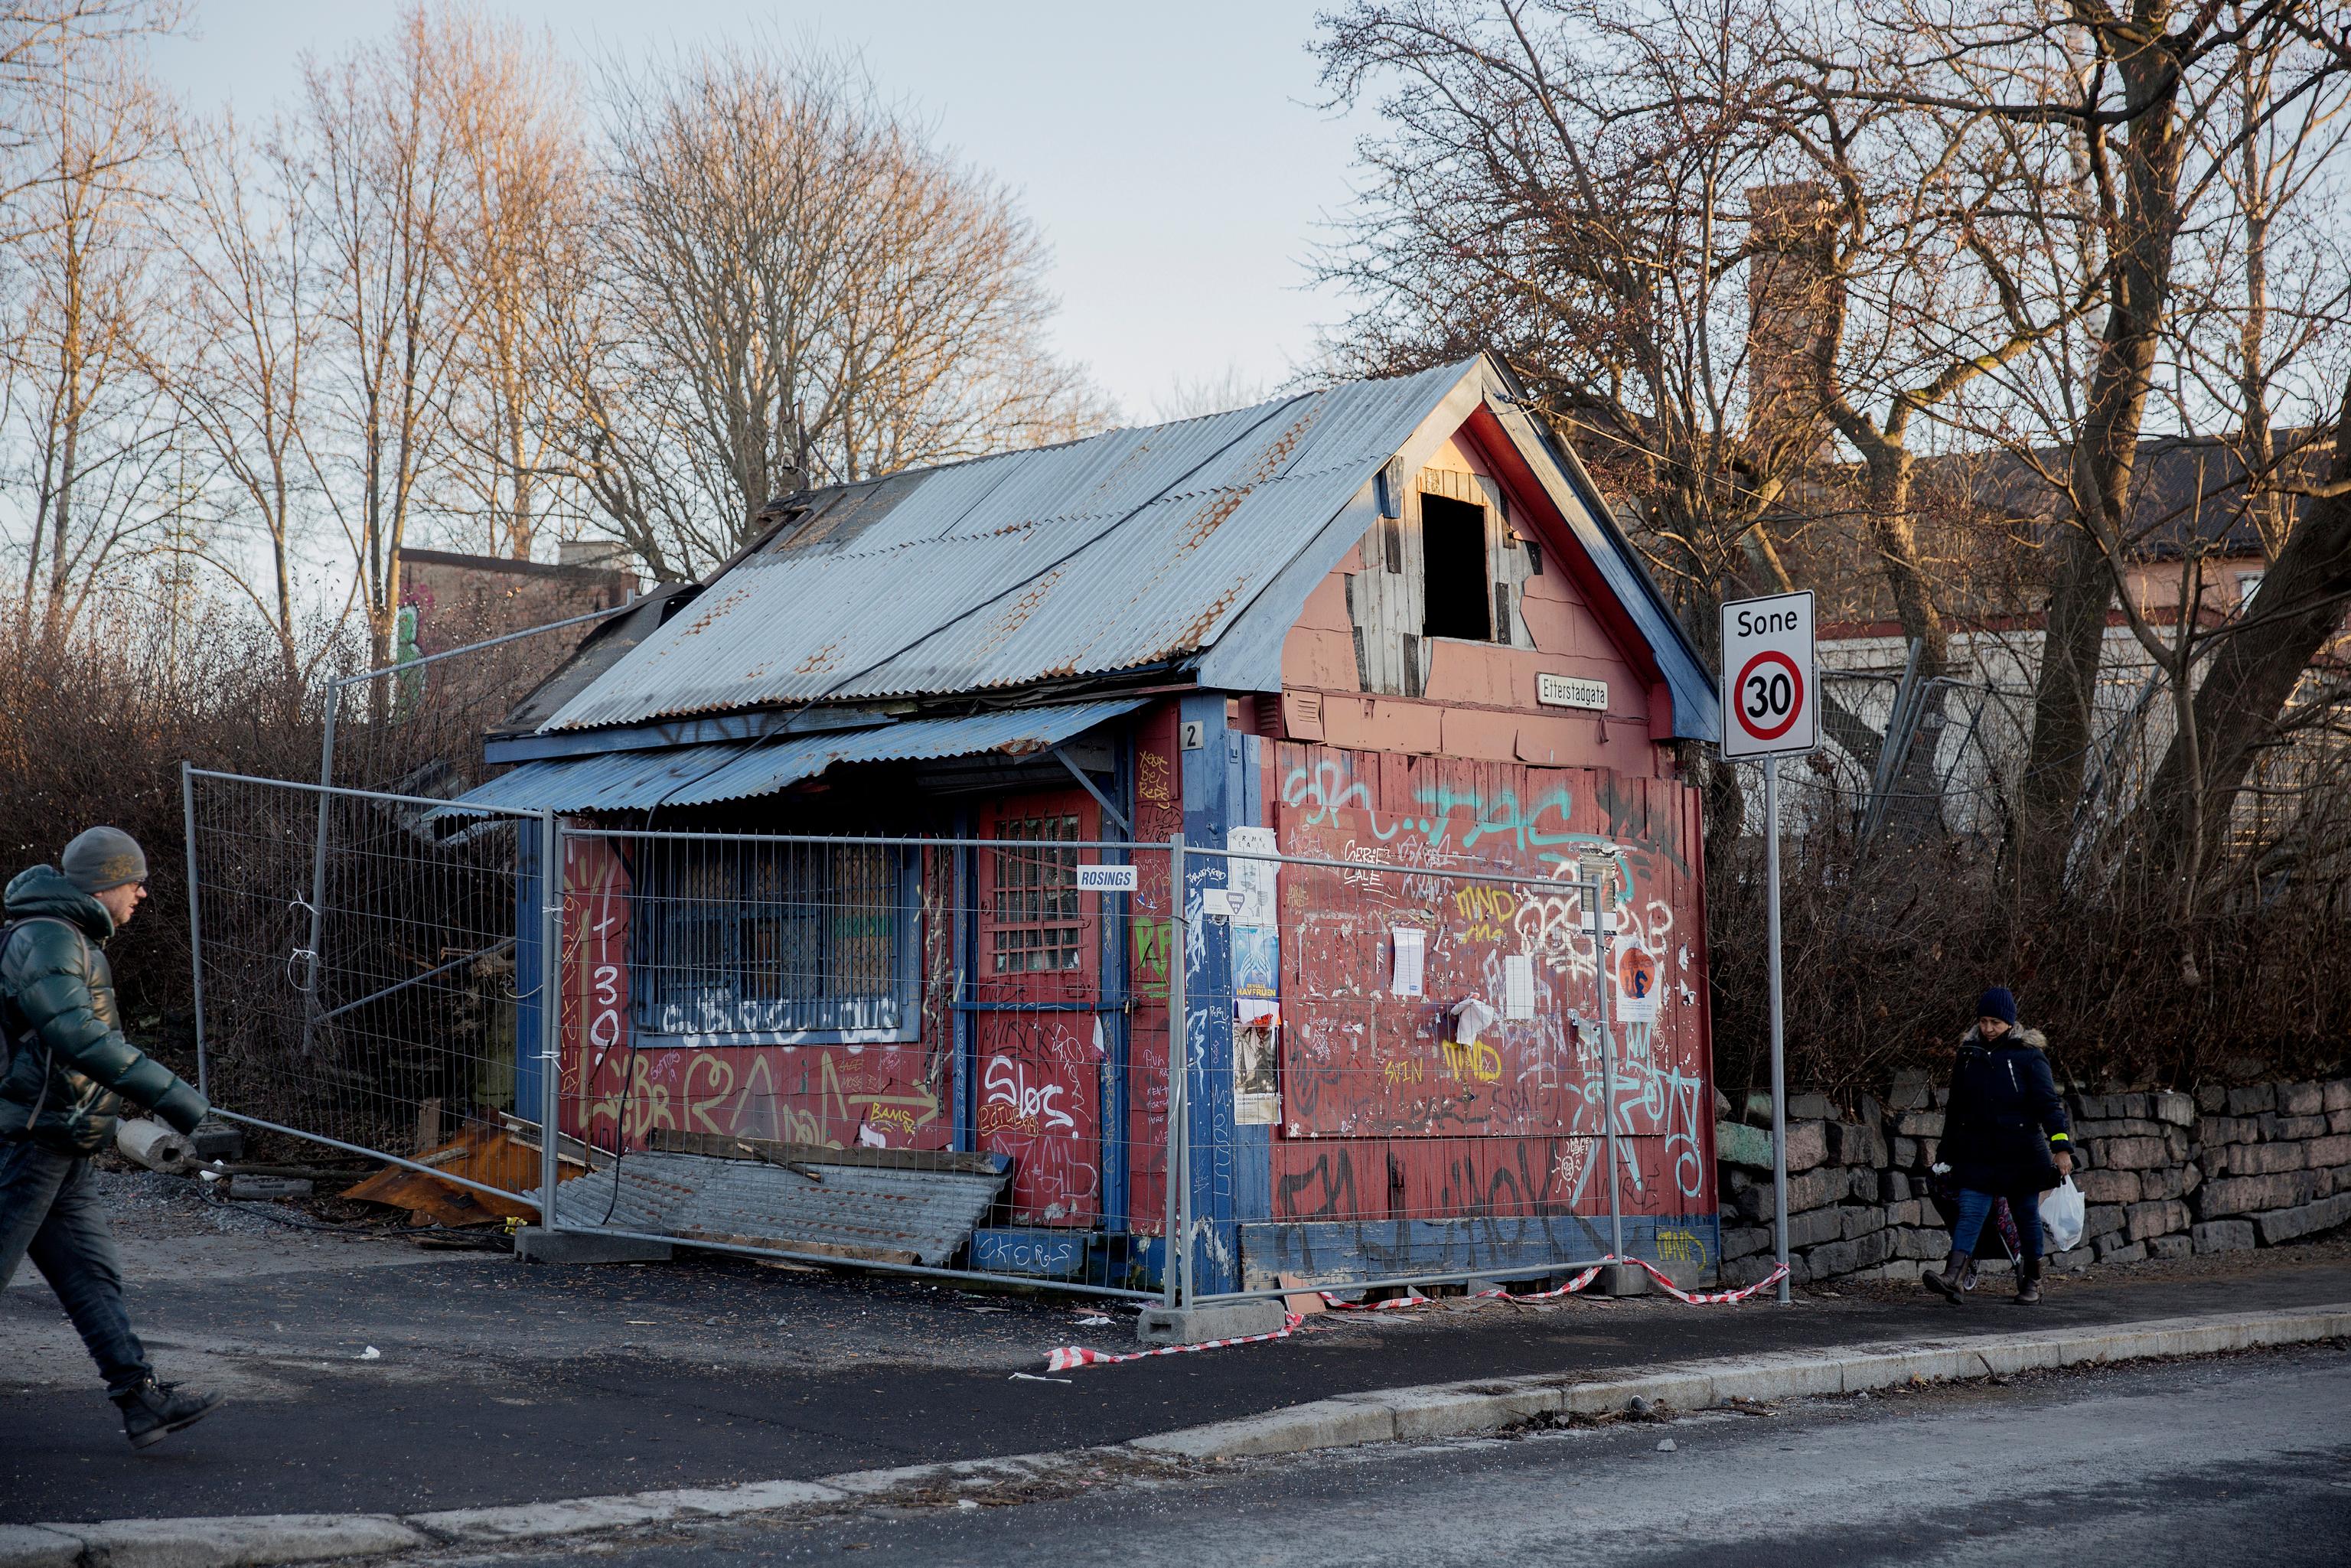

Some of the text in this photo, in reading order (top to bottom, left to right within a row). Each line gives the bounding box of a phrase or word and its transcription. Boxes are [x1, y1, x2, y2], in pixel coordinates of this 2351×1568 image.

[1737, 610, 1798, 638] Sone
[1543, 679, 1605, 706] Etterstadgata
[1746, 673, 1792, 719] 30
[1186, 725, 1196, 747] 2
[1081, 872, 1131, 886] ROSINGS
[1236, 988, 1277, 996] HAVFRUEN
